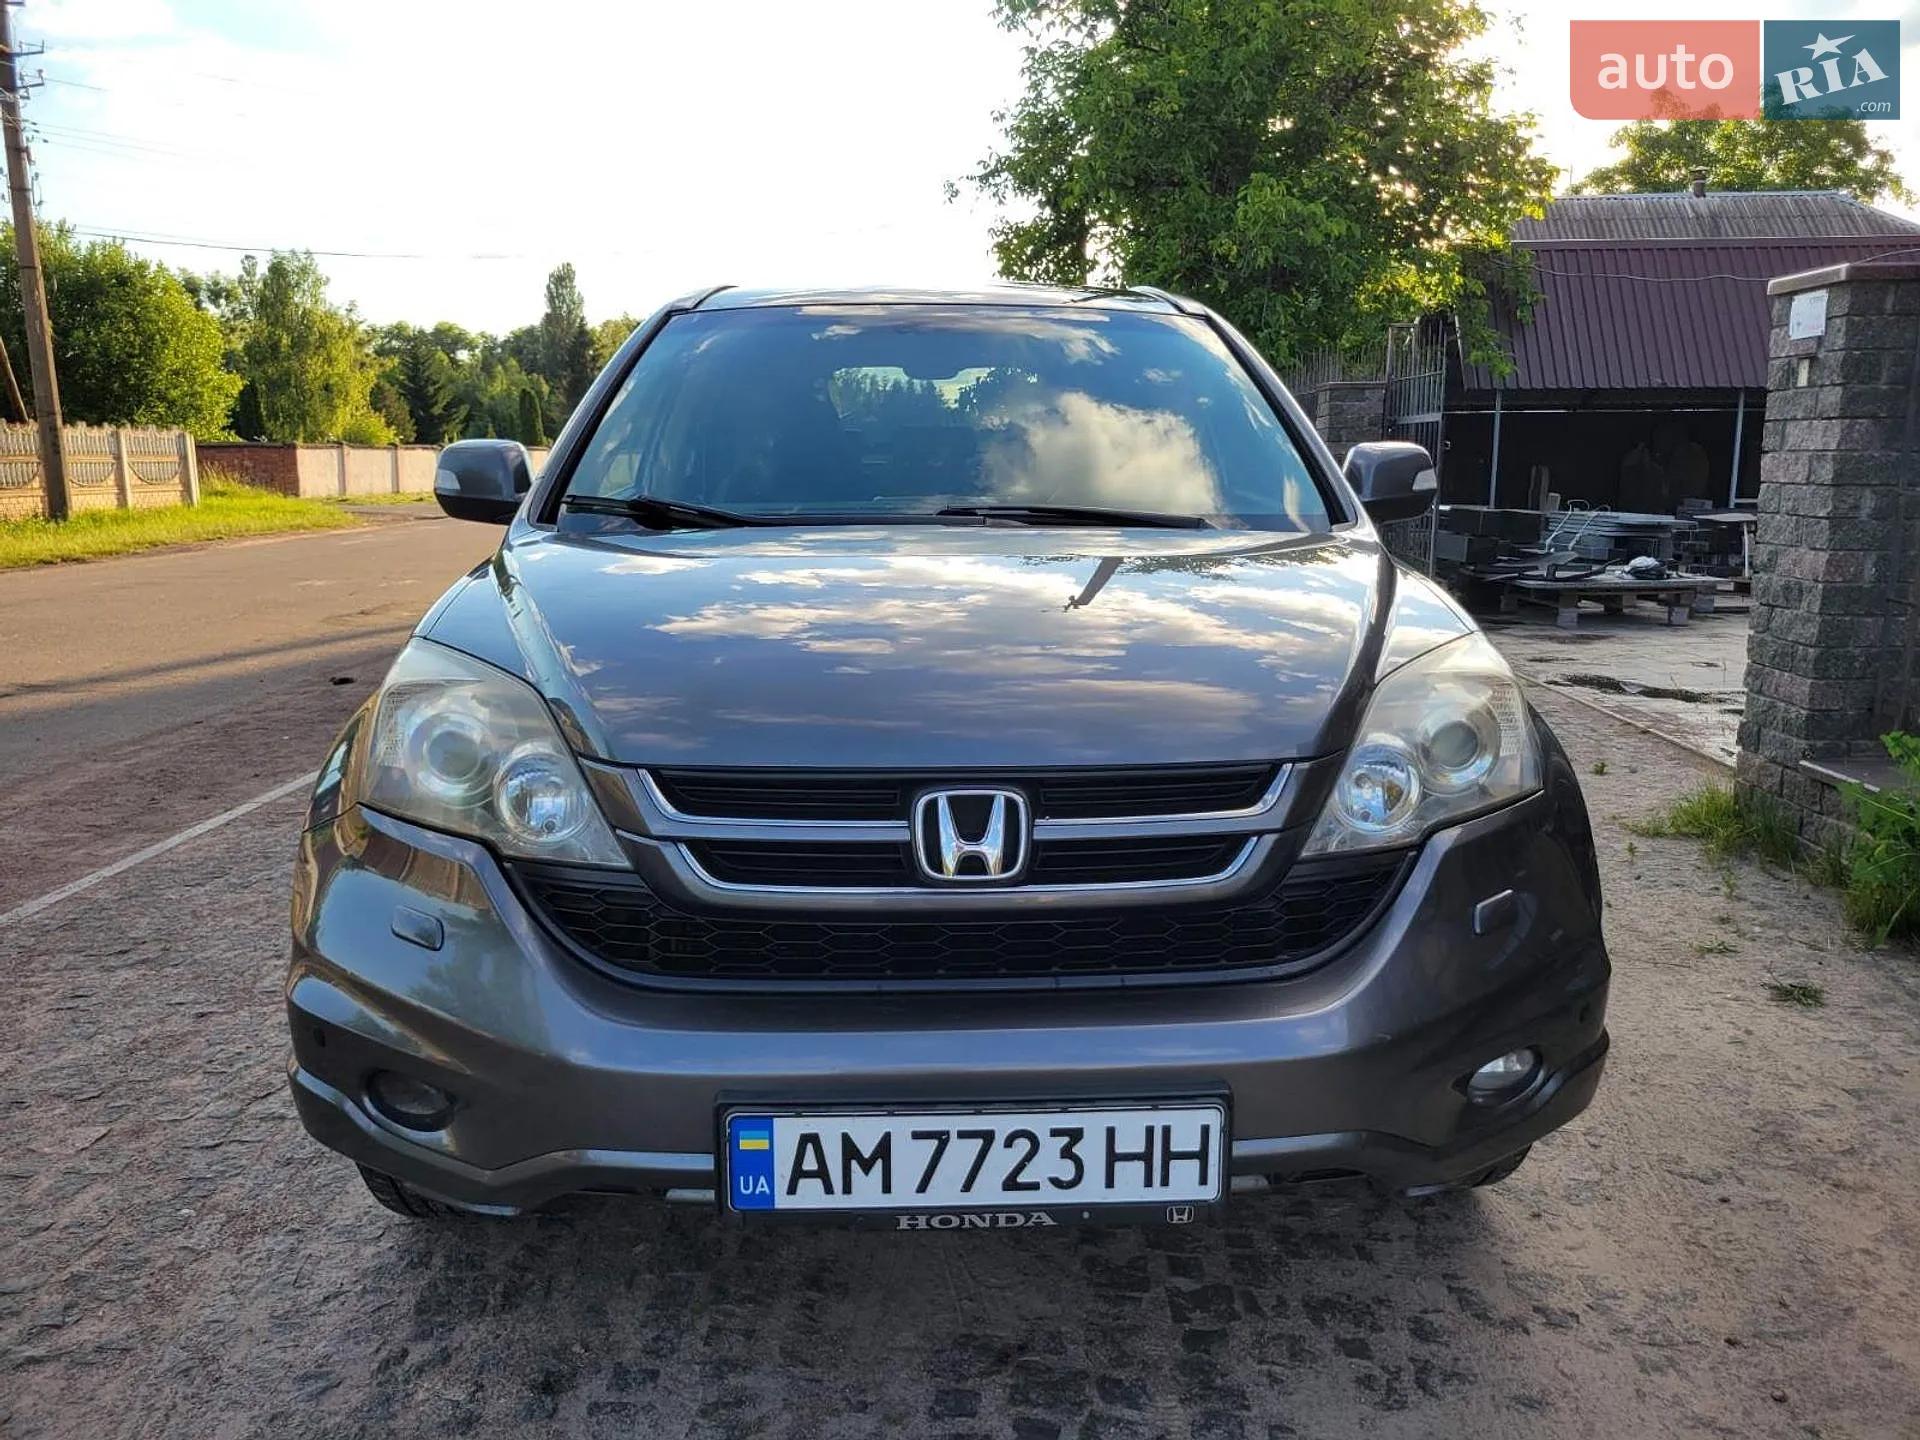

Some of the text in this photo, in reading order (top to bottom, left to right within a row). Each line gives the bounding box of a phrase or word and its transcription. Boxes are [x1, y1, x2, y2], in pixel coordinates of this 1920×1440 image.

[786, 1124, 1211, 1196] AM 7723 HH
[739, 1175, 771, 1196] UA
[896, 1211, 1059, 1231] HONDA
